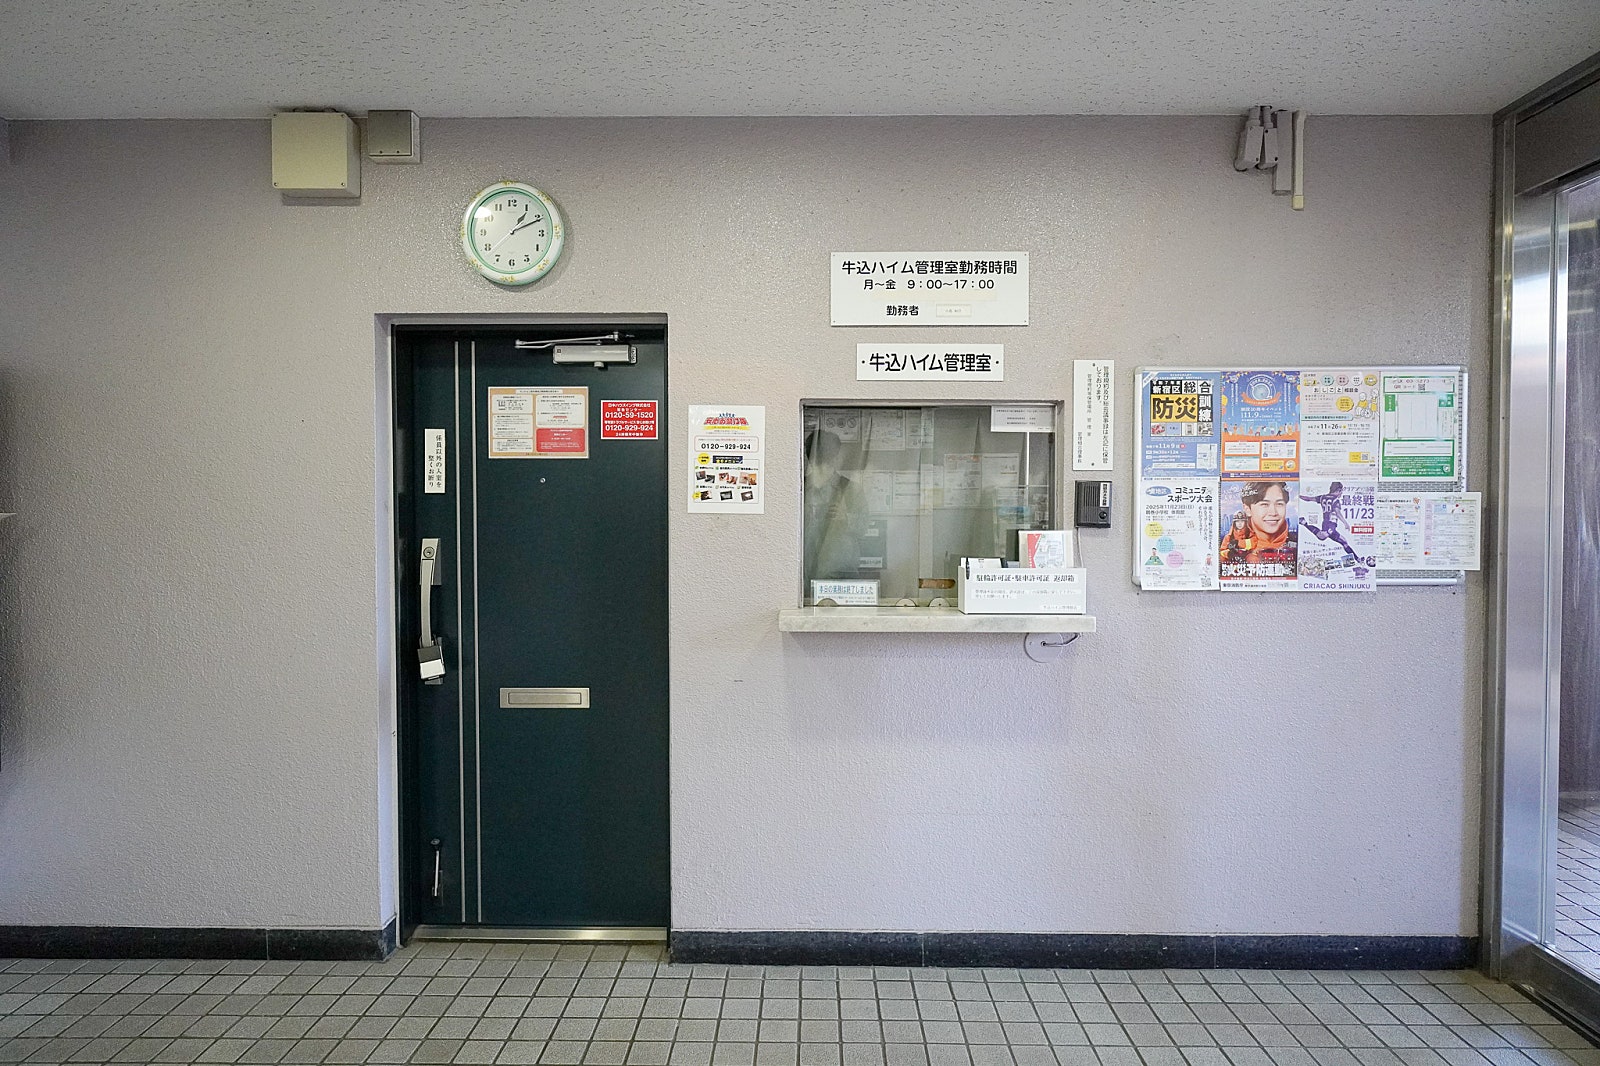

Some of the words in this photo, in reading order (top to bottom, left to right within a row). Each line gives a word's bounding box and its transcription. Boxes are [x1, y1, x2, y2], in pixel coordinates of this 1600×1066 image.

[495, 203, 502, 211] 11
[507, 199, 517, 207] 12
[535, 214, 541, 222] 2
[538, 229, 545, 237] 3
[484, 243, 491, 251] 8
[495, 254, 501, 262] 7
[523, 254, 530, 262] 5
[508, 259, 515, 267] 6
[842, 260, 1017, 275] 牛込ハイム管理室勤務時間
[886, 305, 920, 316] 勤務者
[869, 353, 992, 372] 牛込ハイム管理室
[1152, 385, 1181, 394] 新宿区
[1152, 397, 1196, 420] 防災
[1198, 395, 1212, 422] 訓練
[1175, 486, 1211, 494] コミュニテ
[1167, 495, 1213, 503] スポーツ大会
[1341, 495, 1375, 506] 最終戦
[1343, 508, 1375, 519] 11/23
